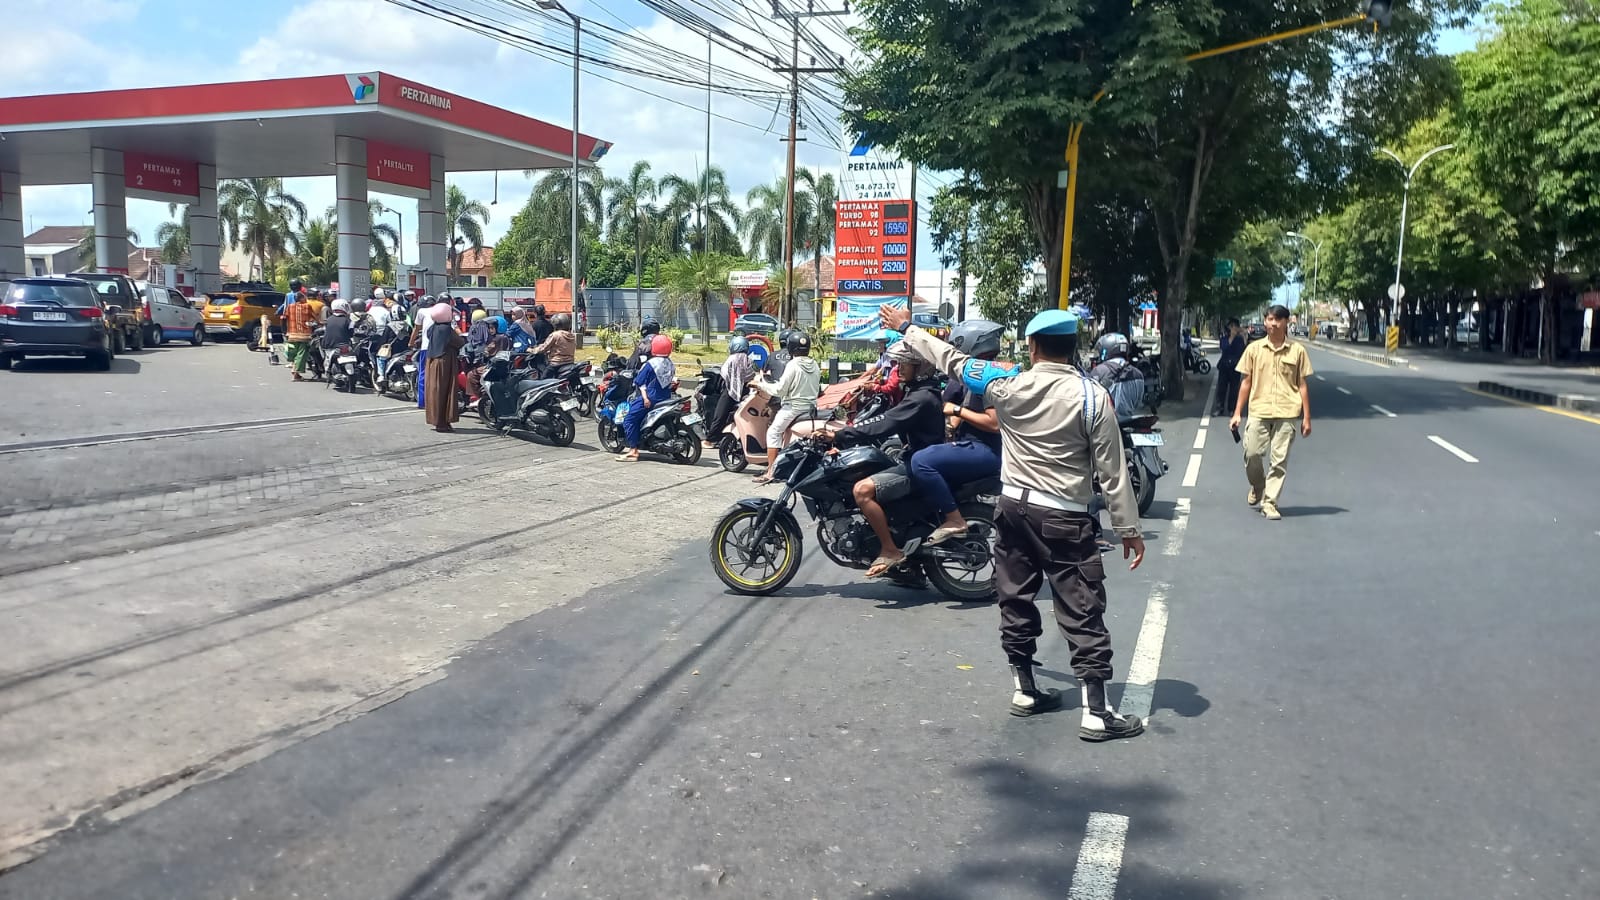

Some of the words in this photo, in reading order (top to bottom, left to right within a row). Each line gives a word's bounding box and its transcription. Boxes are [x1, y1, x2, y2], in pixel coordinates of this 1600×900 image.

[400, 86, 452, 110] PERTAMINA
[143, 162, 181, 175] PERTAMAX
[383, 159, 414, 172] PERTALITE
[848, 161, 904, 171] PERTAMINA
[136, 175, 144, 186] 2
[172, 178, 182, 187] 92
[872, 191, 892, 199] JAM
[839, 203, 880, 211] PERTAMAX
[839, 220, 879, 229] PERTAMAX
[884, 222, 907, 234] 15950
[868, 229, 879, 237] 92
[838, 245, 876, 254] PERTALITE
[883, 243, 907, 255] 10000
[838, 258, 879, 267] PERTAMINA
[882, 261, 906, 273] 25200
